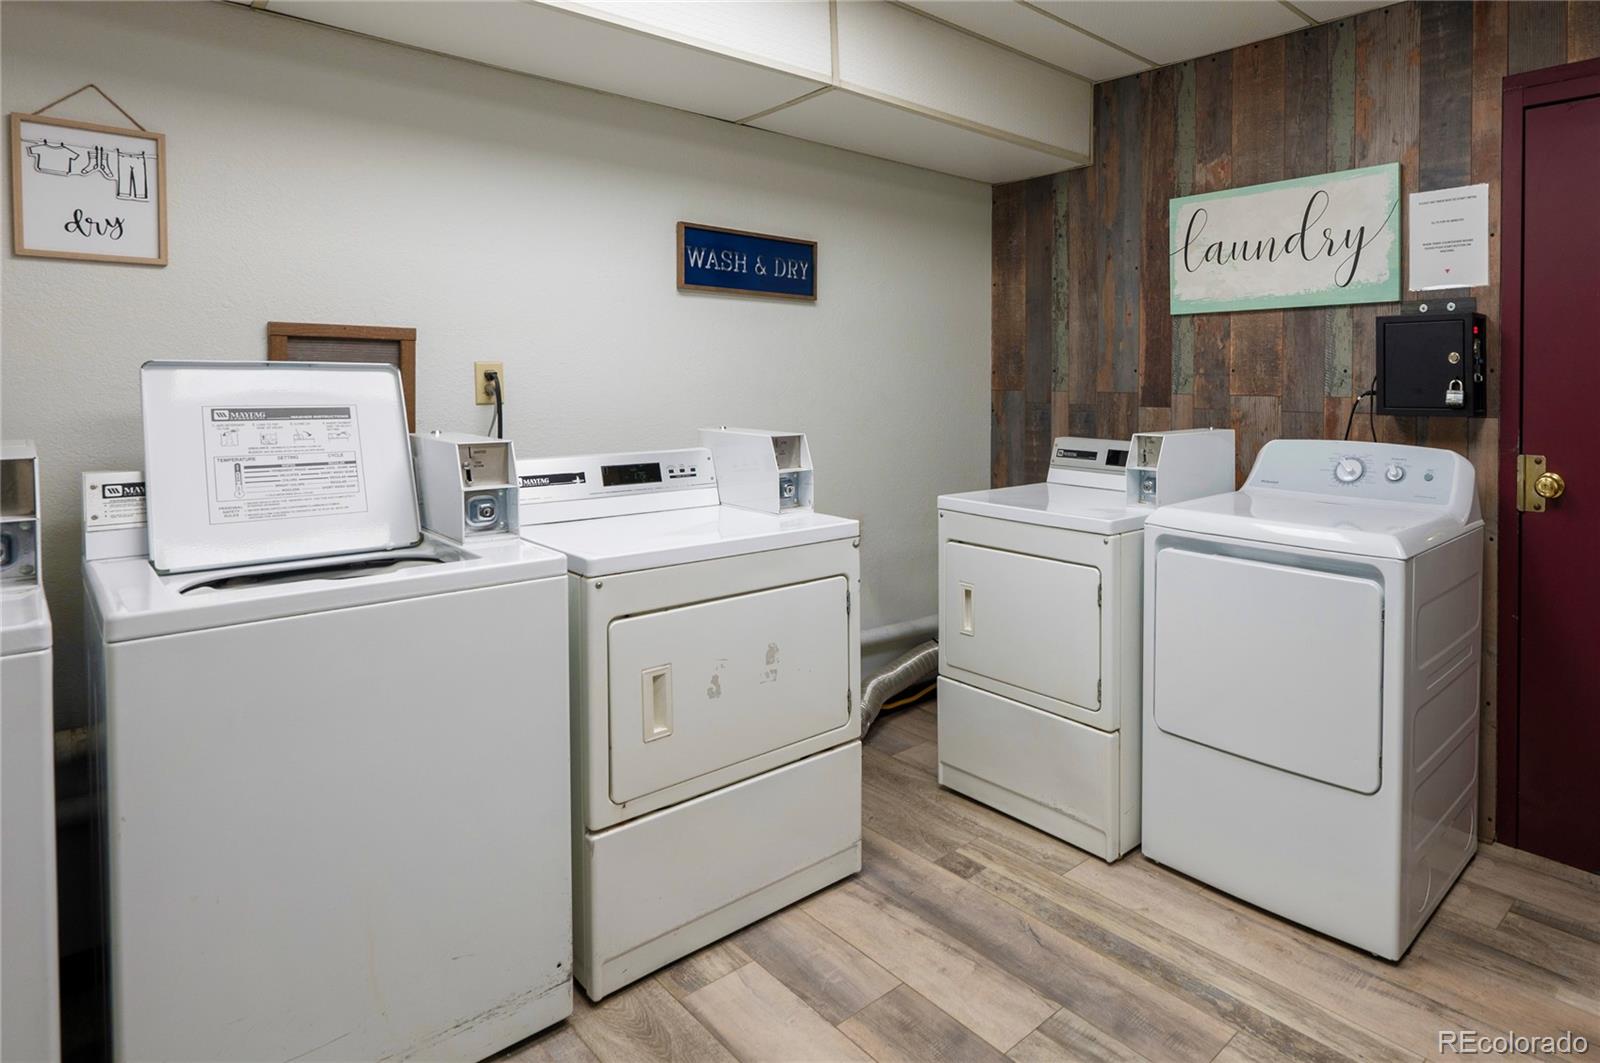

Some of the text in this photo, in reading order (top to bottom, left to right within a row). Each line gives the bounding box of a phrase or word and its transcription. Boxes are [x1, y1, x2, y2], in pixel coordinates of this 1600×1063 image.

[64, 209, 125, 241] dry
[1169, 190, 1399, 287] laundry
[686, 245, 809, 280] WASH & DRY
[229, 411, 267, 420] MAYTAG
[522, 477, 550, 487] MAYTAG
